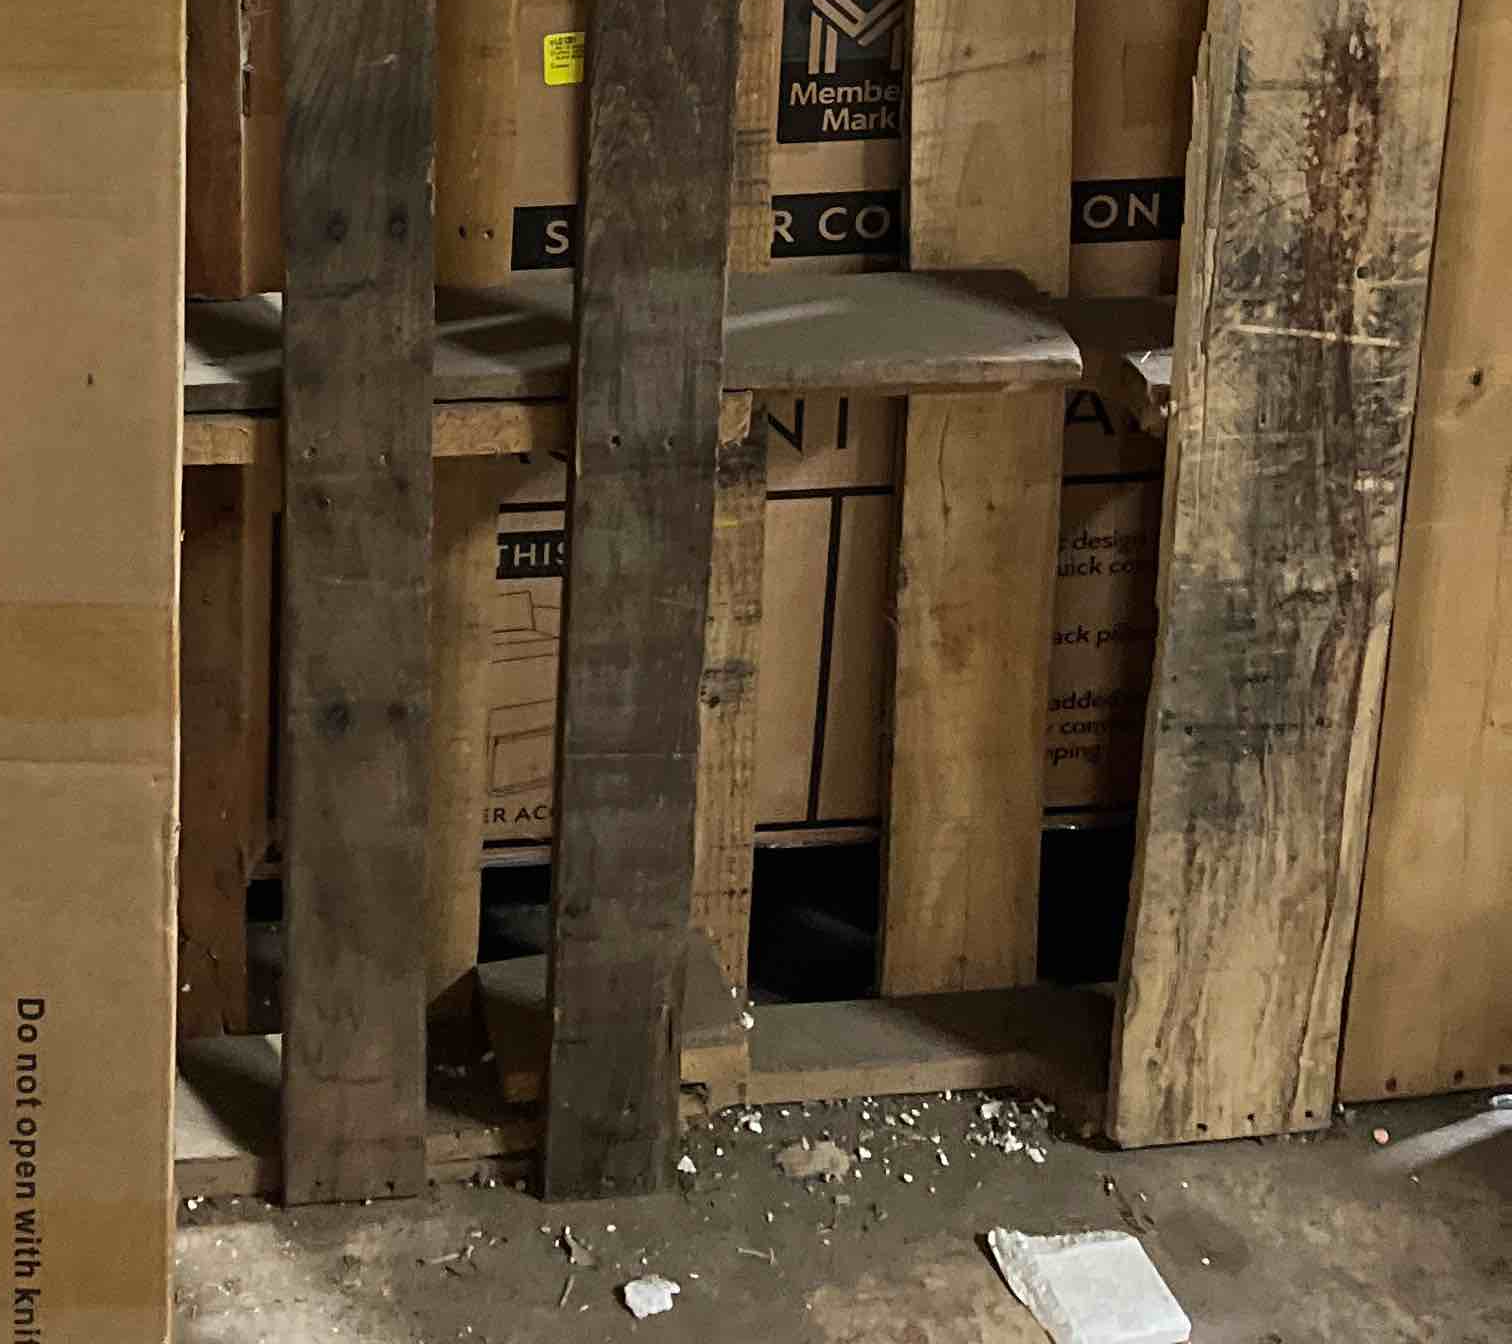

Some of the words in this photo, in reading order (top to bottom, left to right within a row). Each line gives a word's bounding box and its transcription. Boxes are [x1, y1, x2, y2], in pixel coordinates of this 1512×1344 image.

[790, 80, 902, 108] Membe
[822, 109, 895, 133] Mark
[15, 997, 45, 1044] Do
[15, 1052, 41, 1106] not
[8, 1115, 39, 1197] open
[13, 1208, 41, 1278] with
